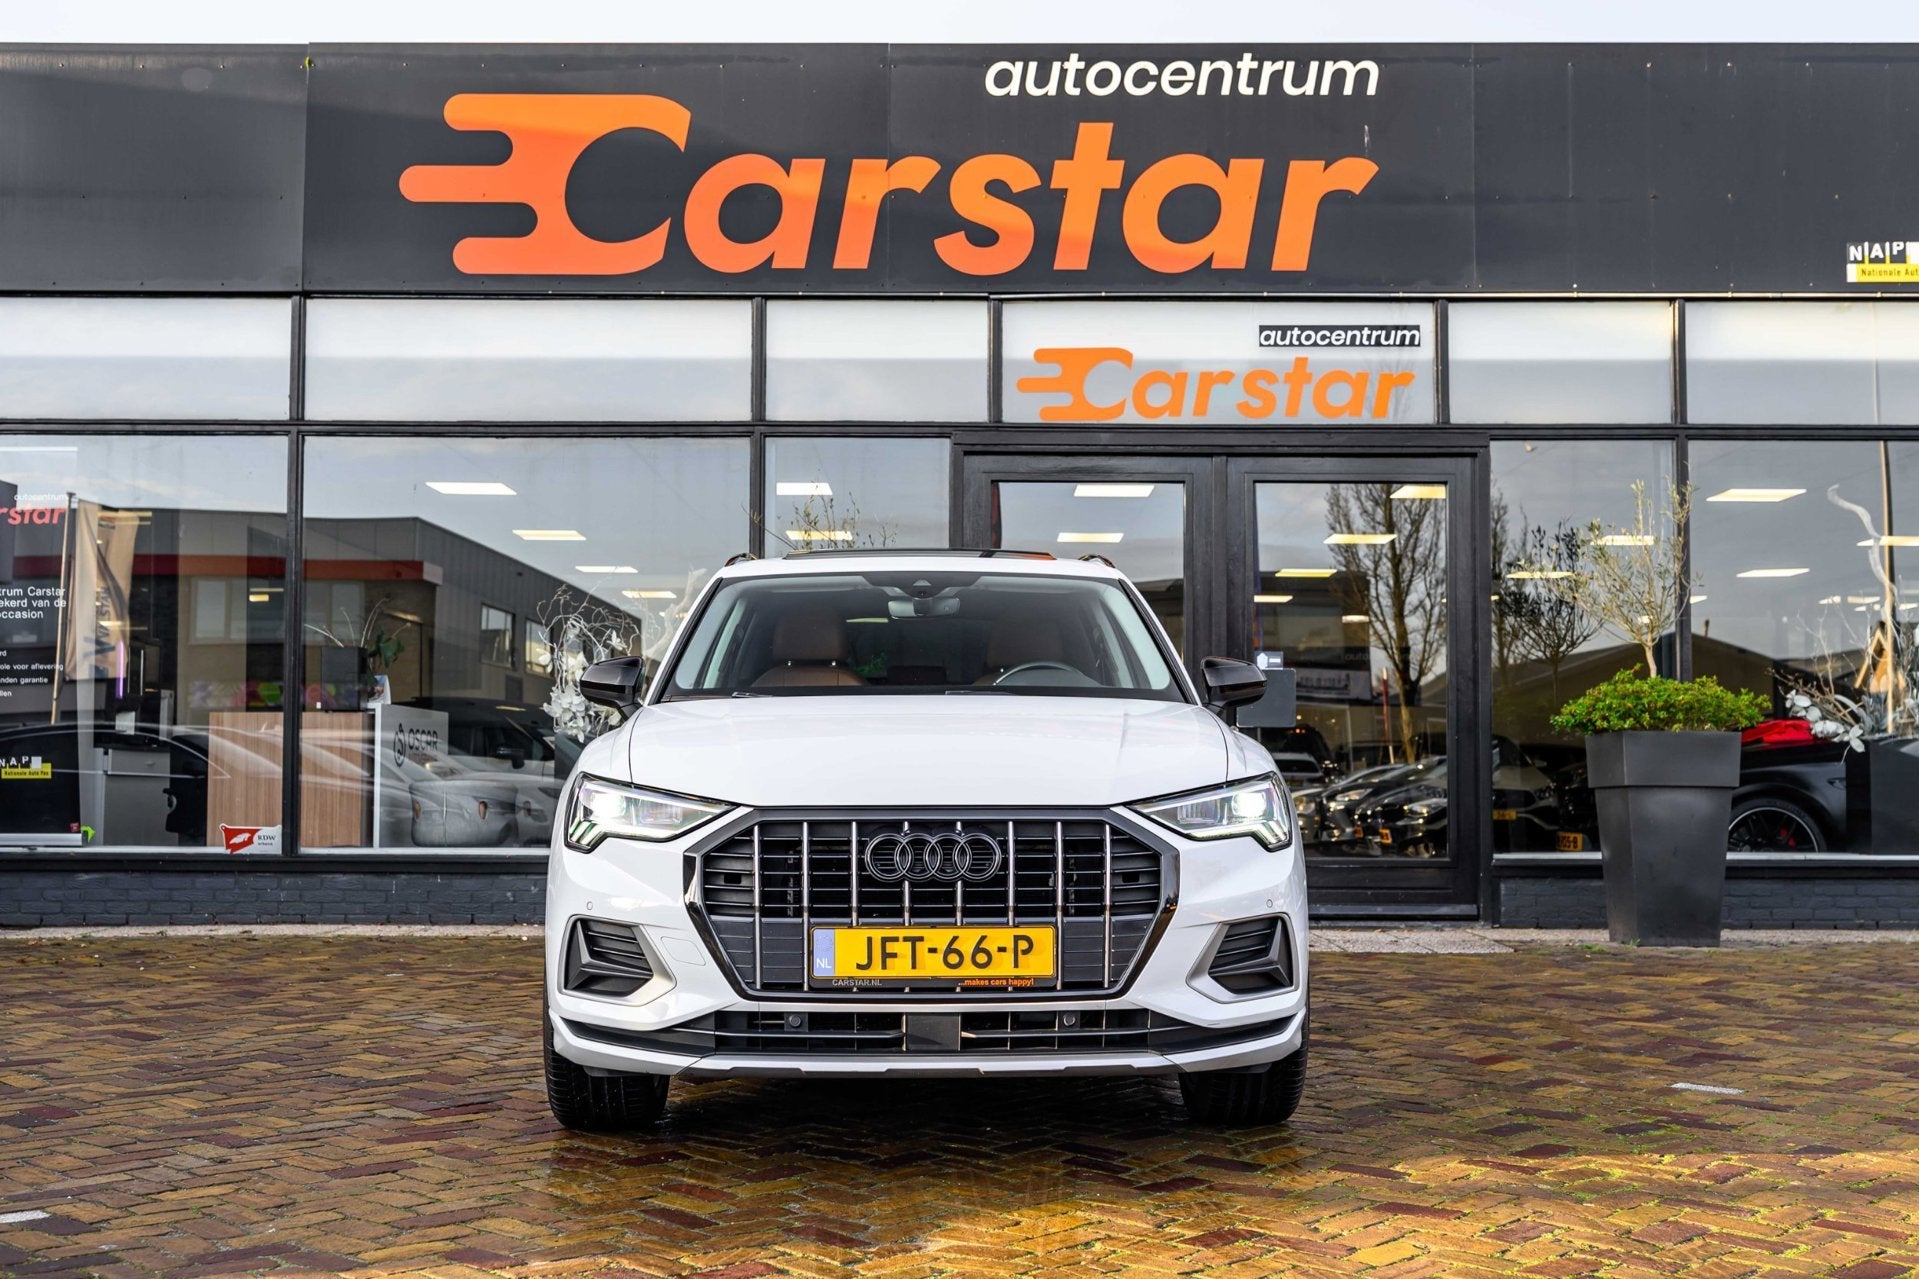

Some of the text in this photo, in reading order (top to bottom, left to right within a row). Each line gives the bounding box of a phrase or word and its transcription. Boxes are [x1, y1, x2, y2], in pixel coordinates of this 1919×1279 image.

[985, 52, 1379, 97] autocentrum
[399, 93, 1380, 276] Carstar
[1861, 268, 1901, 277] Nationale
[1259, 327, 1421, 346] autocentrum
[1016, 347, 1417, 422] Carstar
[27, 586, 66, 597] Carstar
[31, 599, 50, 608] van
[53, 597, 67, 608] de
[30, 663, 64, 671] aflevering
[20, 677, 49, 685] garantie
[408, 728, 438, 752] OSCAR
[856, 934, 1034, 971] JFT-66-P
[816, 957, 832, 969] NL
[832, 978, 883, 986] CARSTAR.NL
[1008, 978, 1035, 987] happy!
